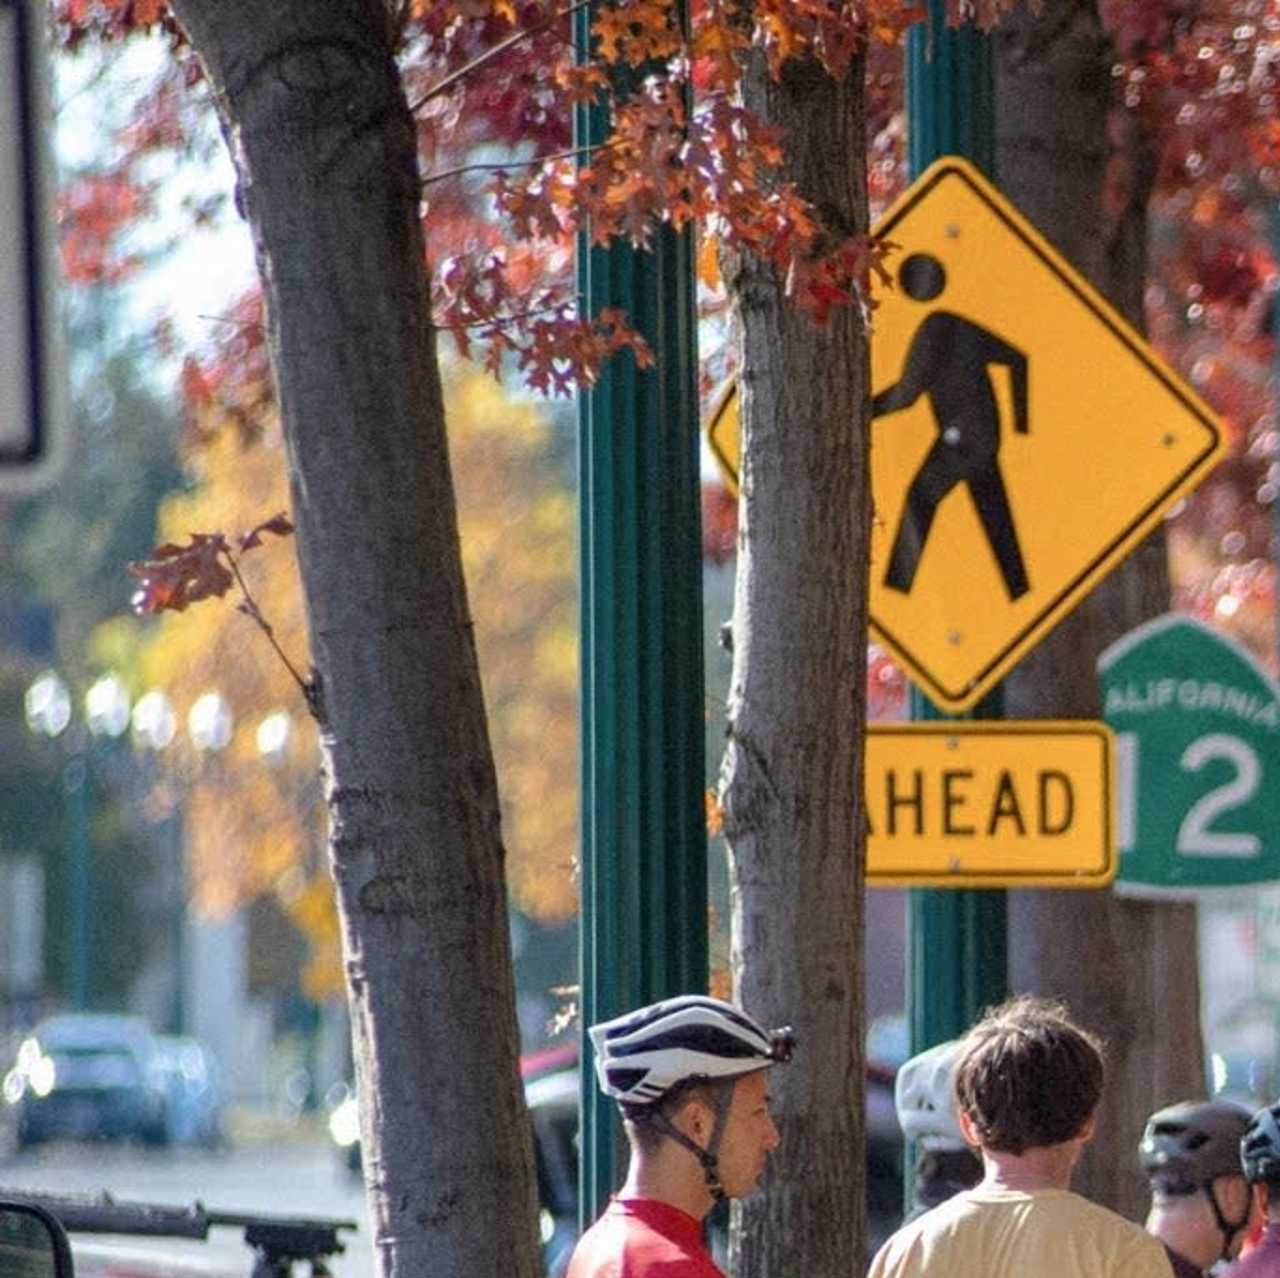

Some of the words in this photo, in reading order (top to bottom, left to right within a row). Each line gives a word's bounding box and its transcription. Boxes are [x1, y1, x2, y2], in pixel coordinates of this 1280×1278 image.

[1104, 678, 1279, 727] ALIFORNIA
[864, 769, 1075, 836] HEAD
[1118, 731, 1263, 857] 12
